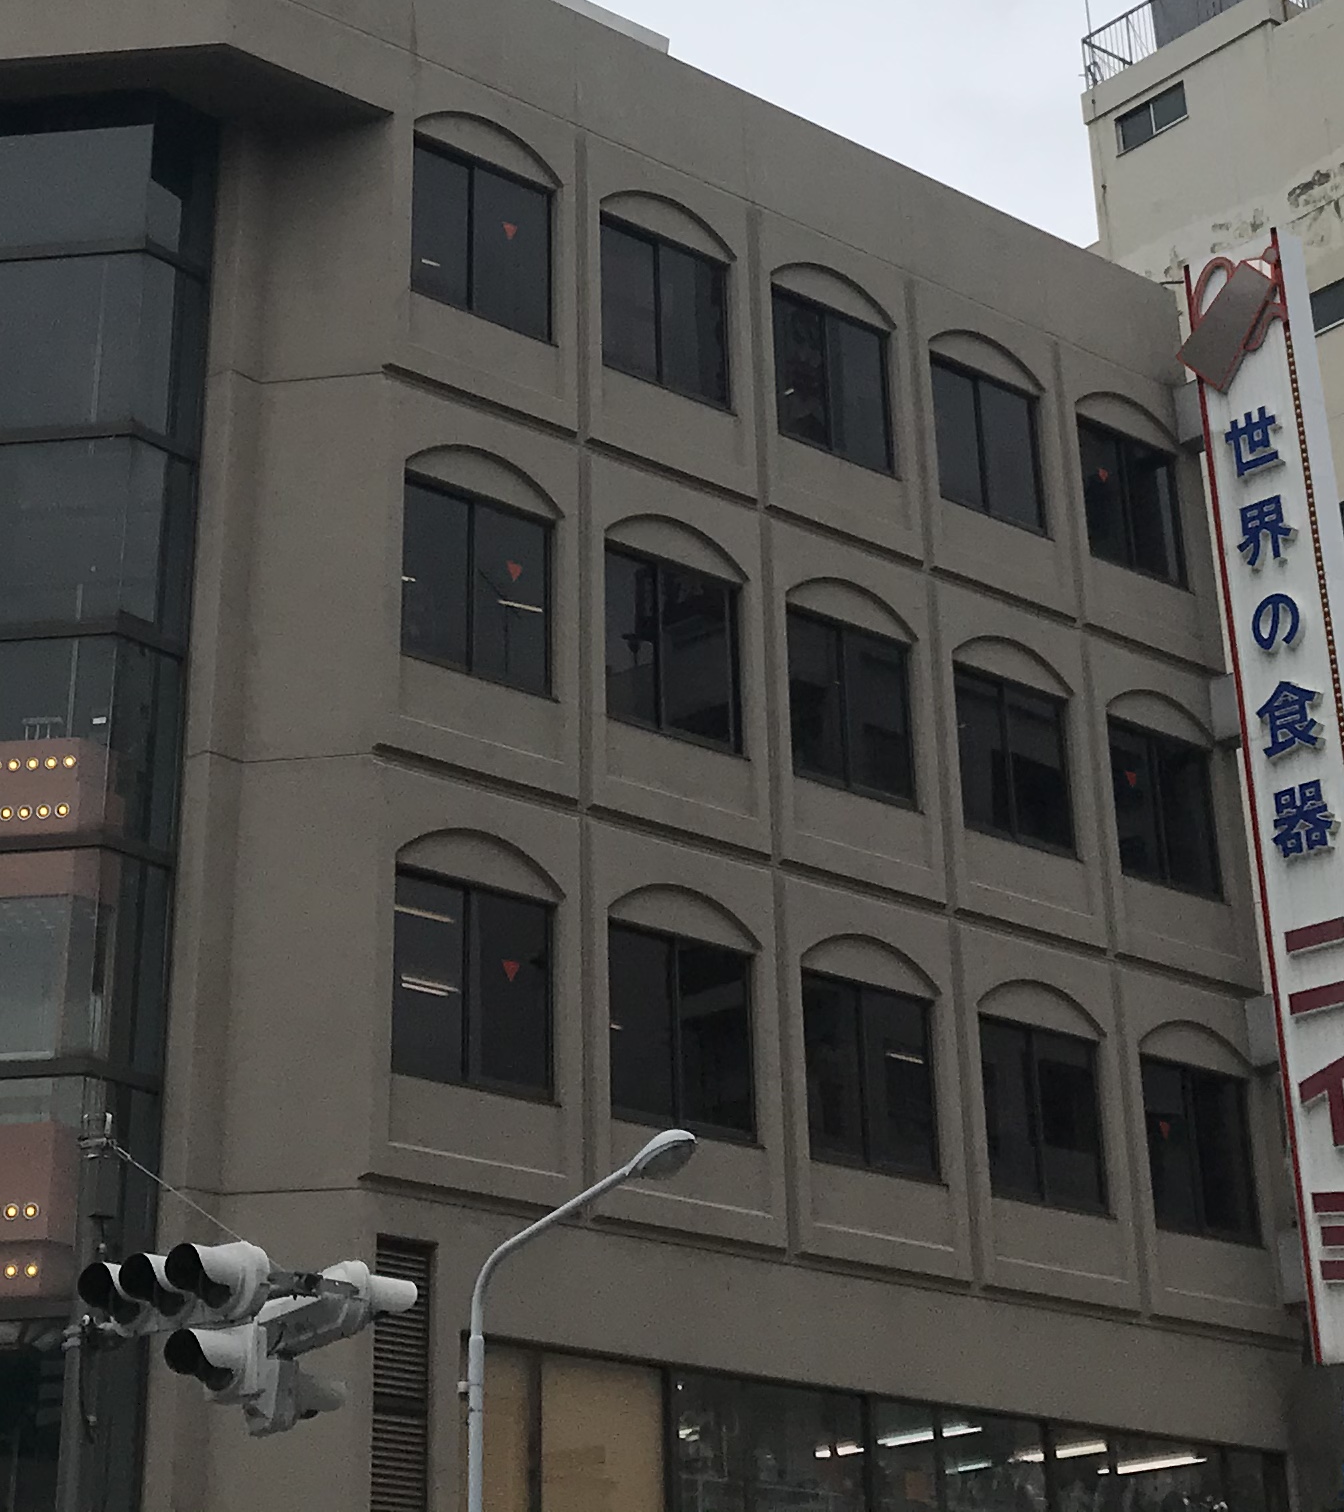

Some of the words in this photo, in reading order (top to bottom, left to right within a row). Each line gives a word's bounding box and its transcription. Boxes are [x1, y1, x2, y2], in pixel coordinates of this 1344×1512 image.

[1225, 406, 1337, 858] 世界の食器
